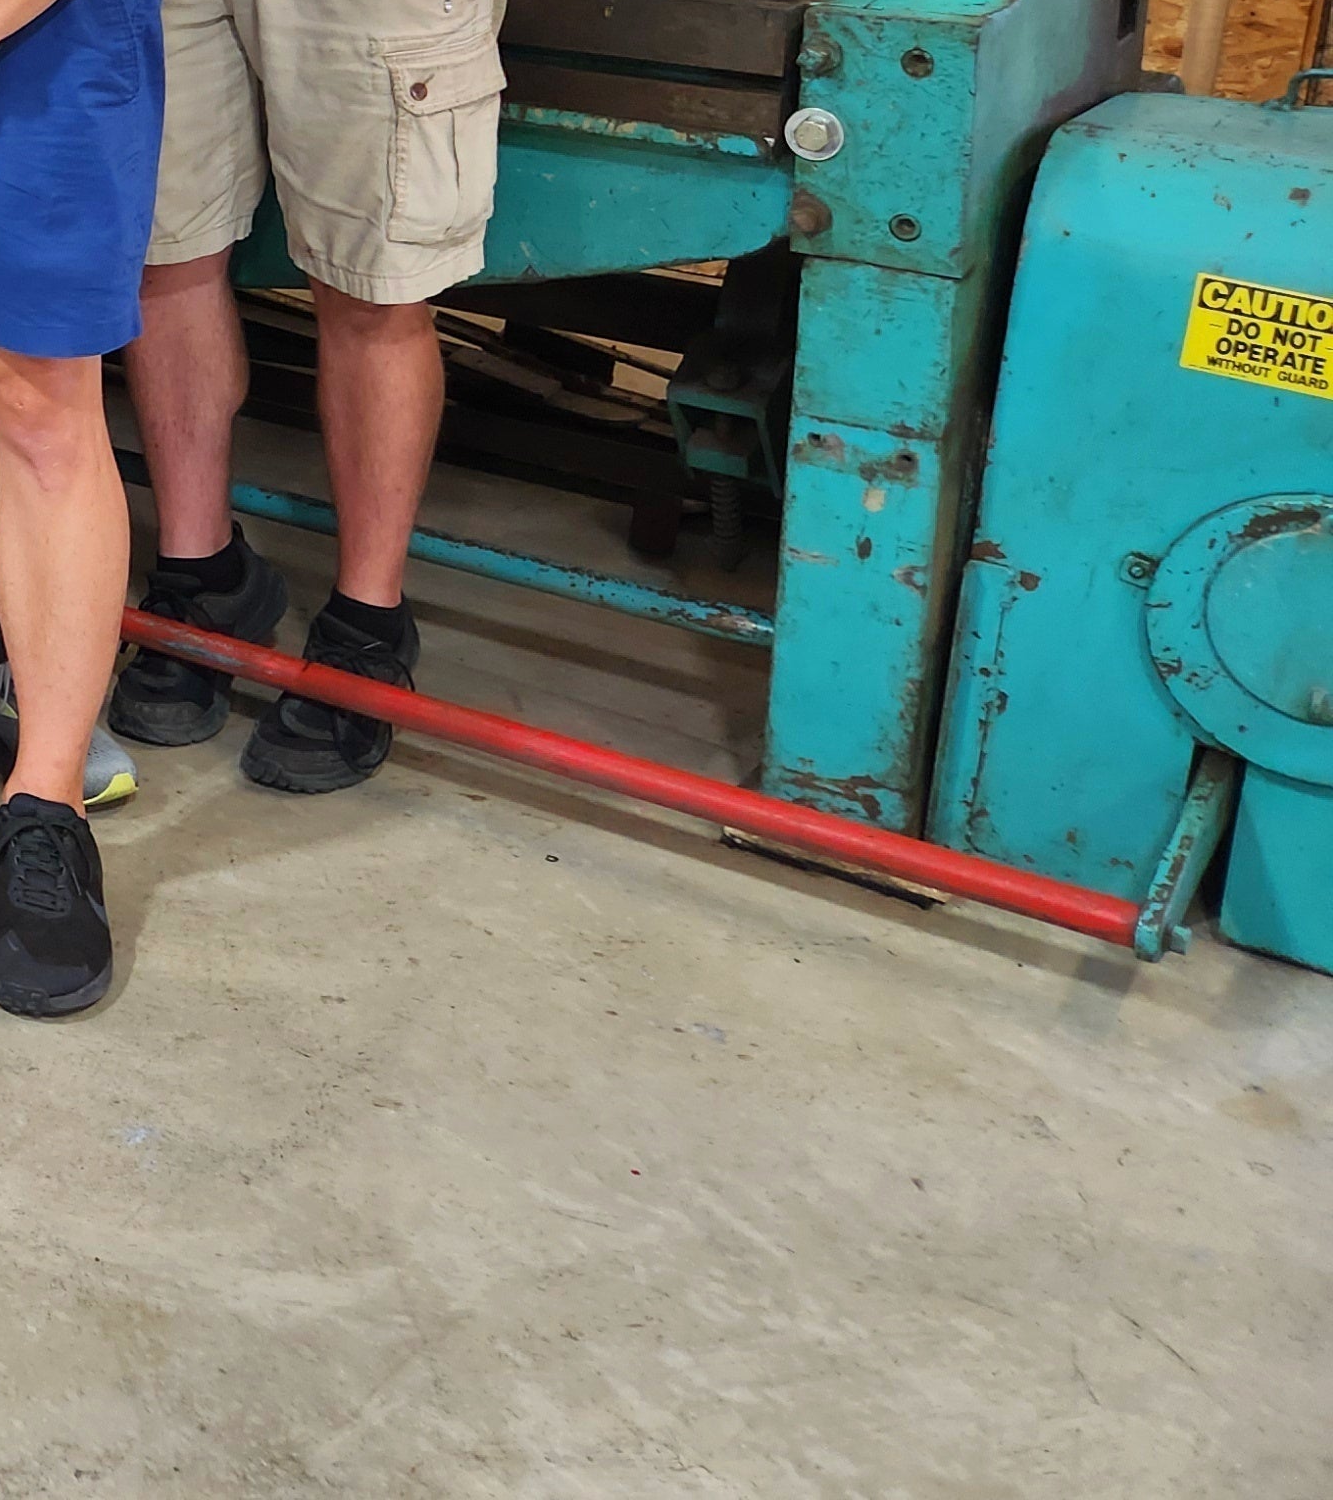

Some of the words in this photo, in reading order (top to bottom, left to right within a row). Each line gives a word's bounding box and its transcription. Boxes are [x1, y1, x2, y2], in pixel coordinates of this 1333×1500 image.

[1226, 318, 1261, 339] DO
[1272, 327, 1323, 352] NOT
[1206, 355, 1271, 378] WITHOUT
[1277, 371, 1330, 390] GUARD
[1215, 337, 1327, 375] OPERATE
